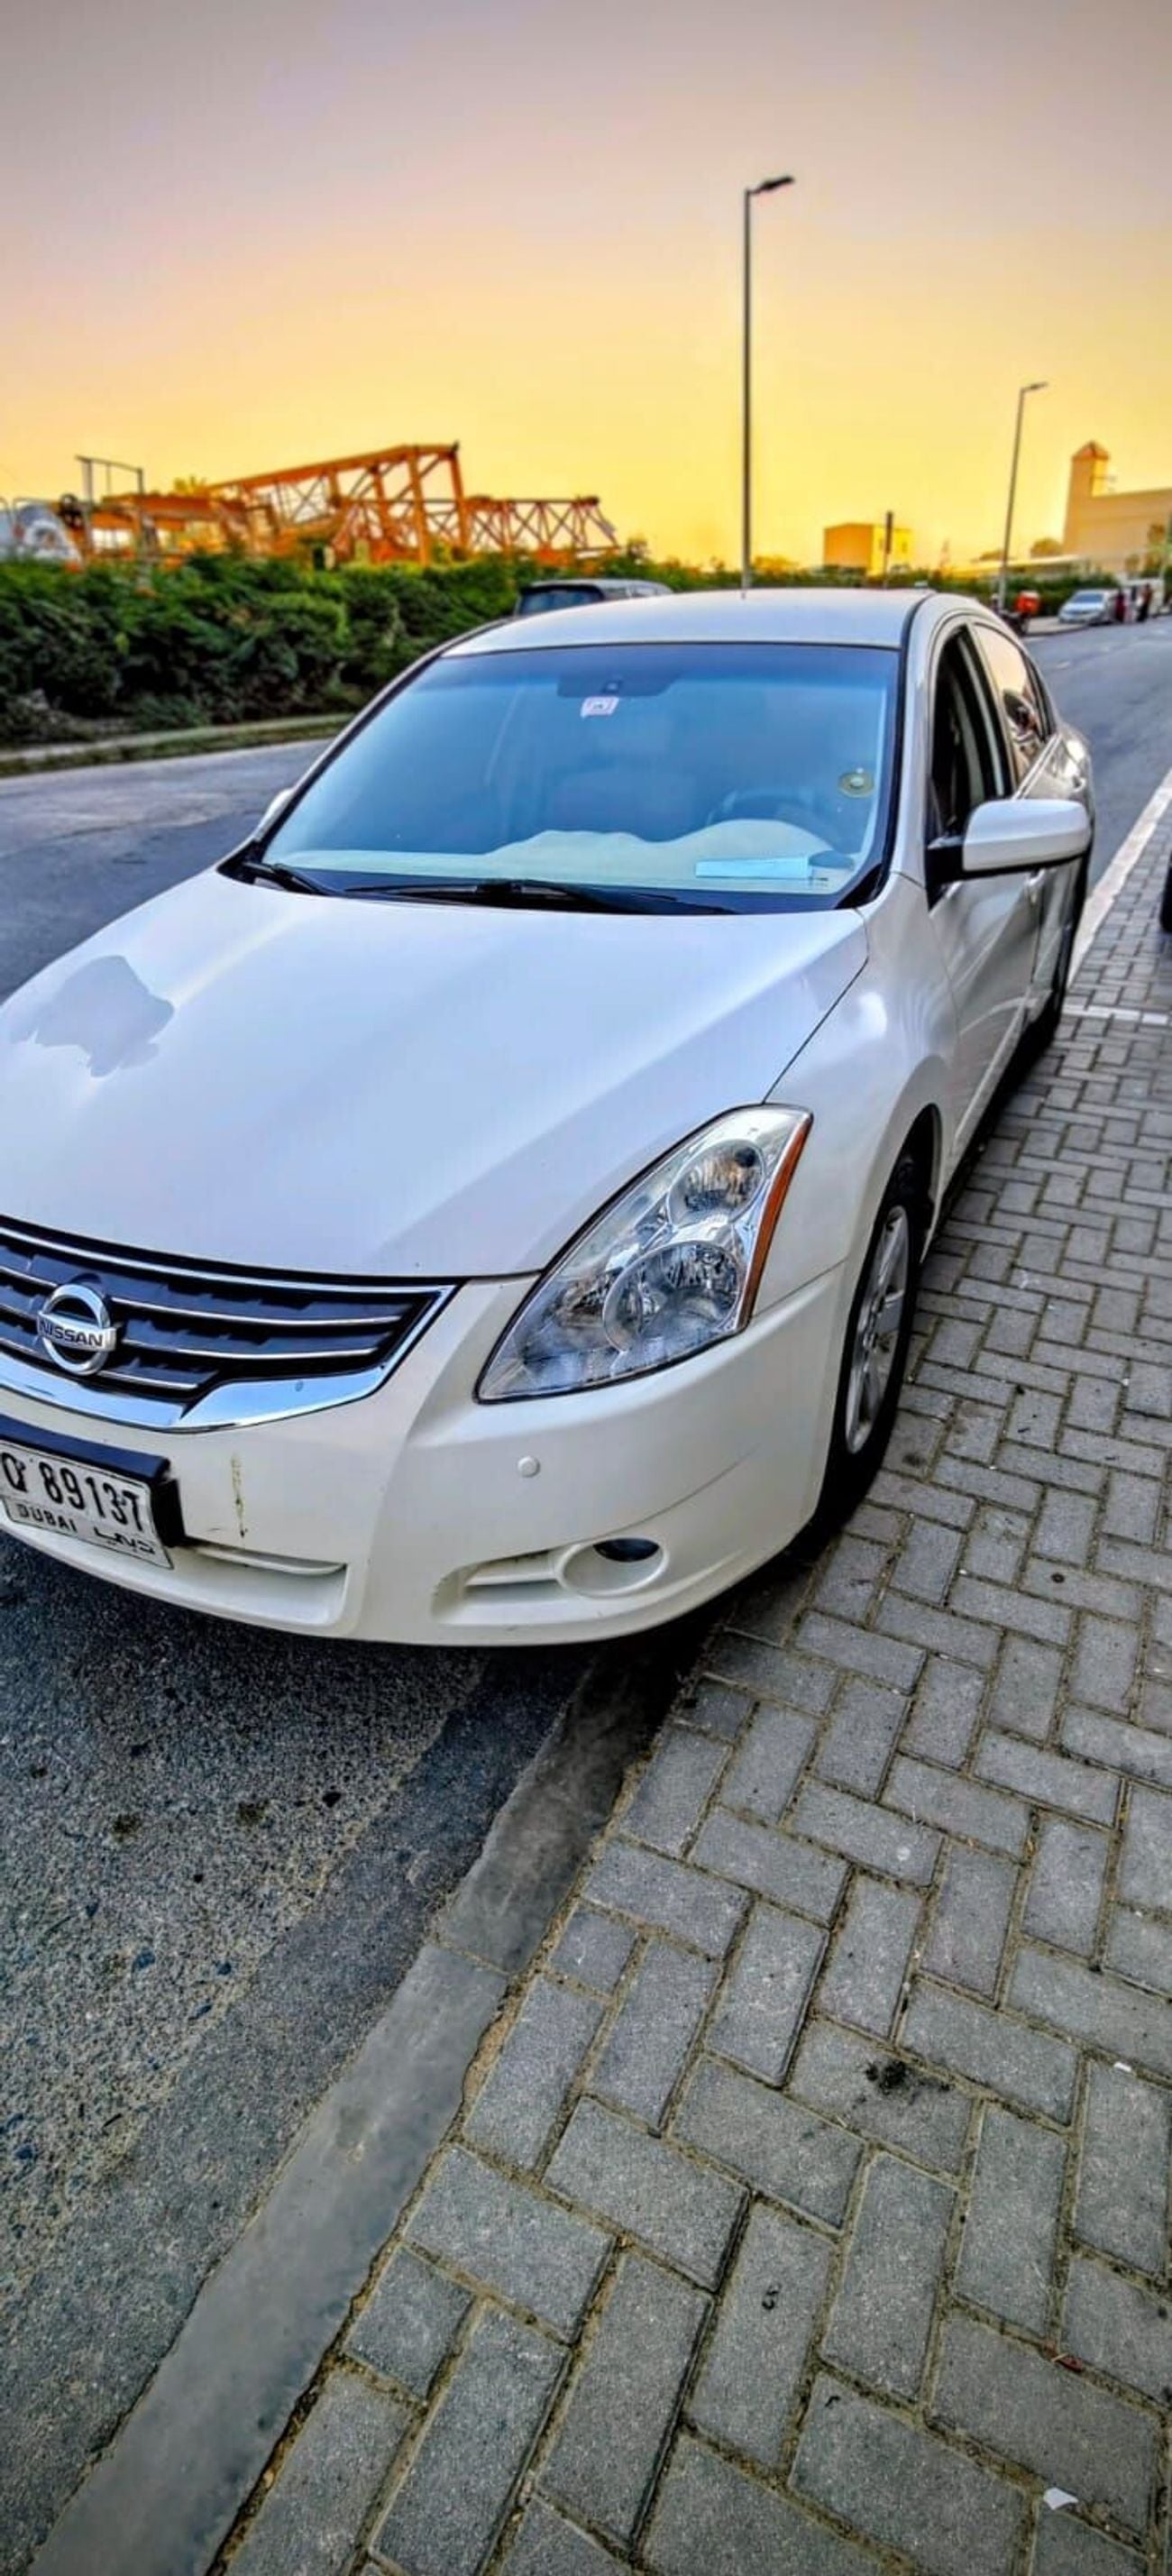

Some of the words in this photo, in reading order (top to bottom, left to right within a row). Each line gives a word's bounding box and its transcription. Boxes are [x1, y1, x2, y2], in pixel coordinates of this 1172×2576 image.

[40, 1317, 103, 1346] NISSAN
[38, 1461, 142, 1532] 89137
[16, 1503, 78, 1532] DUBAI
